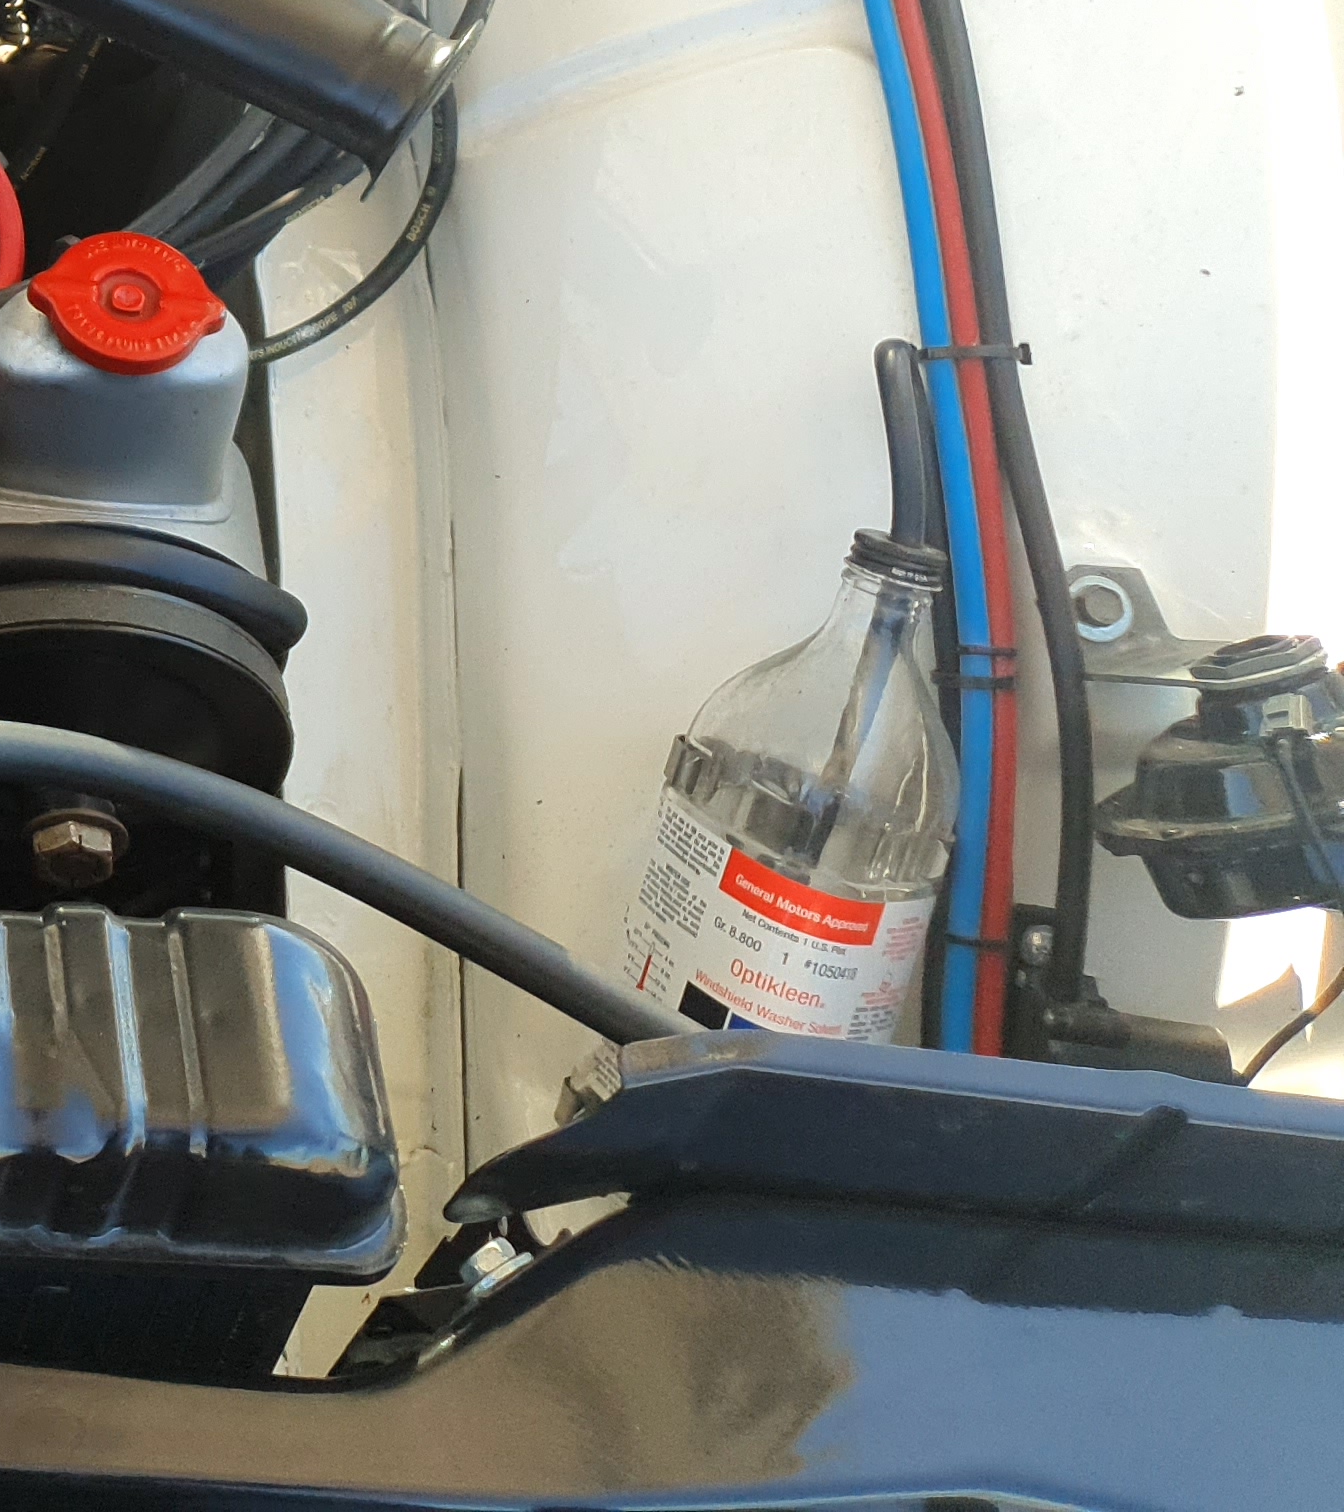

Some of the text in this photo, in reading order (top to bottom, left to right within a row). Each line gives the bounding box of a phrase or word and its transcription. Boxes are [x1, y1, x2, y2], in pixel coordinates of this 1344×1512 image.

[406, 202, 431, 242] BOSCH
[735, 873, 774, 905] General
[776, 896, 822, 924] Motors
[742, 908, 756, 925] Net
[714, 916, 728, 934] Gr.
[695, 968, 754, 1013] Windshield
[756, 1004, 806, 1034] Washer
